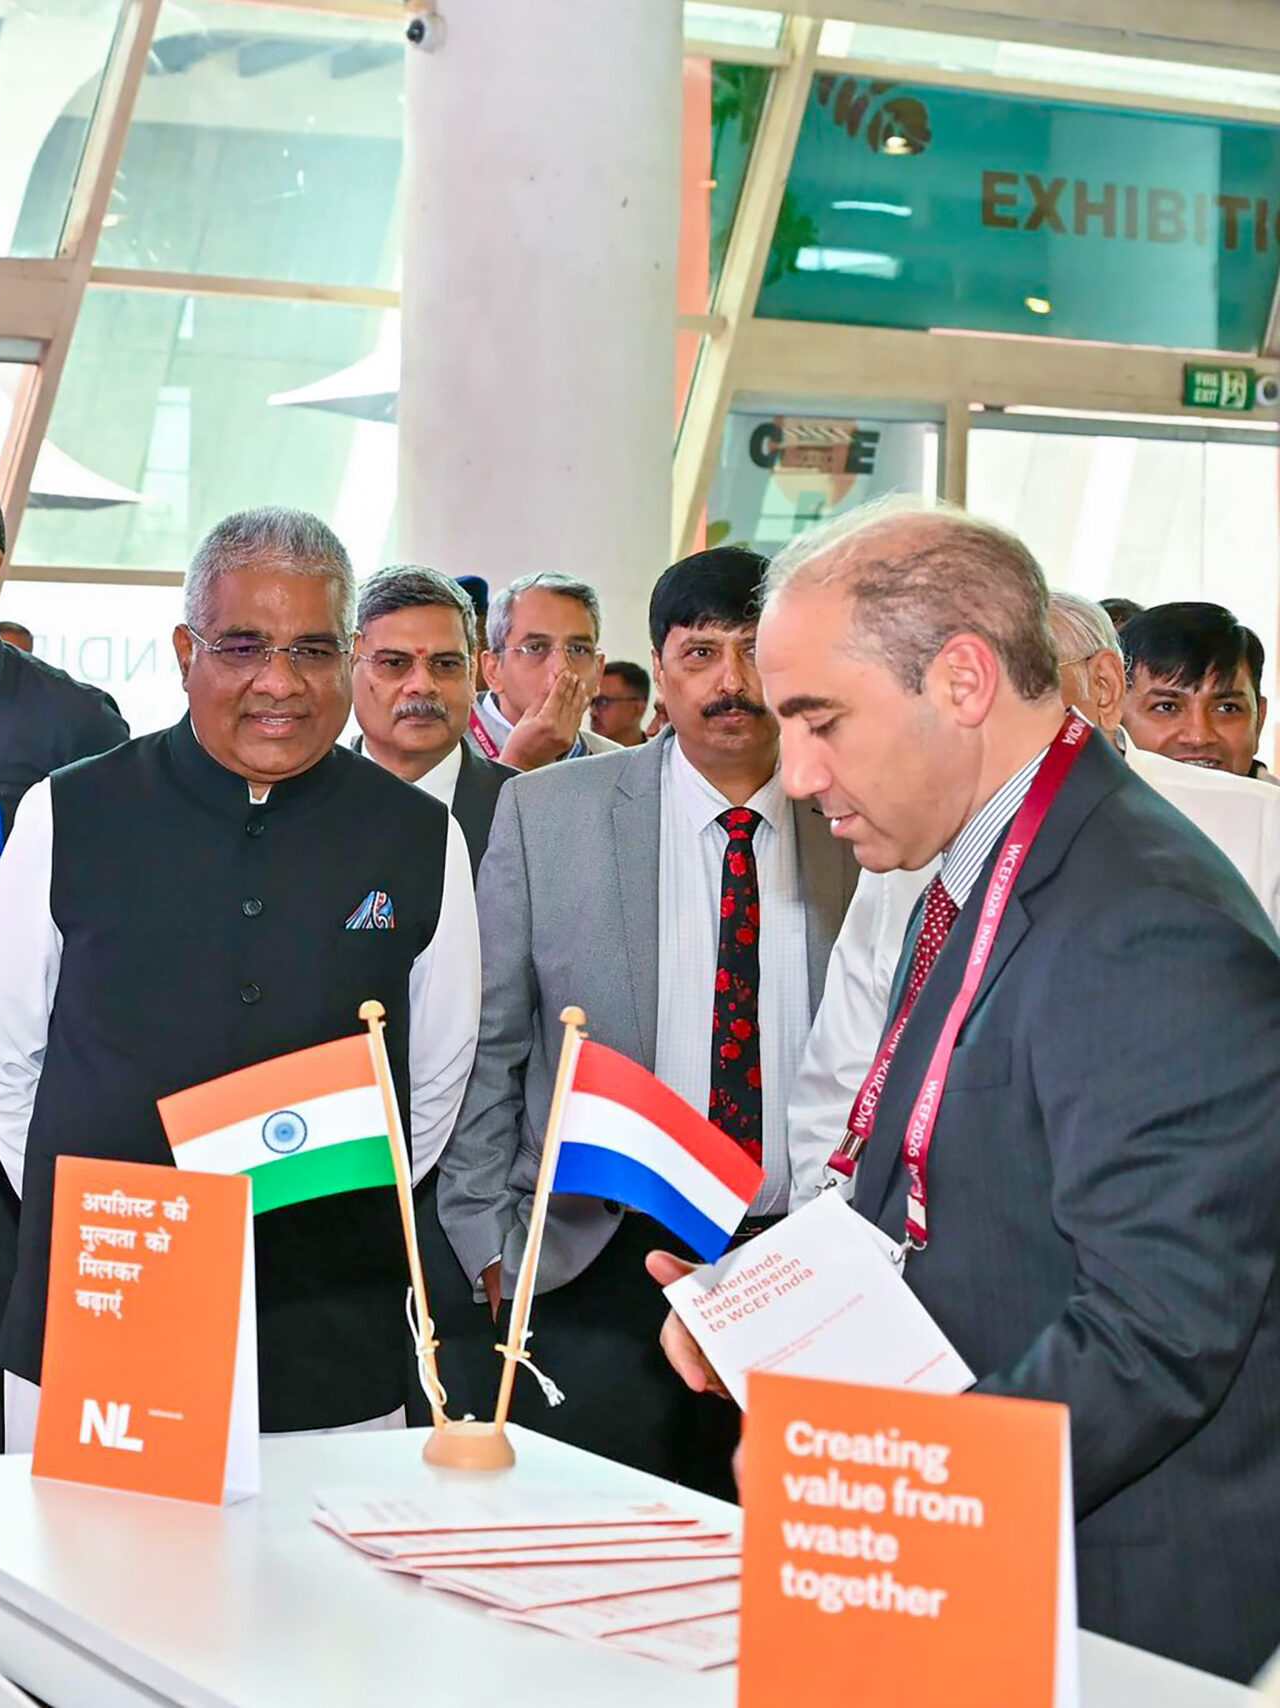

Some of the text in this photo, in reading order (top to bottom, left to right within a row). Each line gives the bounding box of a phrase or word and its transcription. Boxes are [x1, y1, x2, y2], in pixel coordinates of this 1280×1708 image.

[980, 170, 1280, 254] EXHIBITI
[972, 844, 1023, 966] WCEF2026 INDIA
[853, 1059, 891, 1129] WCEF2026
[908, 1079, 939, 1158] WCEF2026
[162, 1195, 190, 1222] की
[78, 1251, 143, 1283] मिलकर
[144, 1225, 172, 1253] को
[691, 1252, 783, 1307] Netherlands
[700, 1258, 801, 1319] trade mission
[708, 1267, 814, 1333] to WCEF India
[79, 1399, 144, 1452] NL
[784, 1420, 951, 1484] Creating
[783, 1468, 984, 1528] value from
[781, 1520, 899, 1563] waste
[780, 1562, 947, 1619] together
